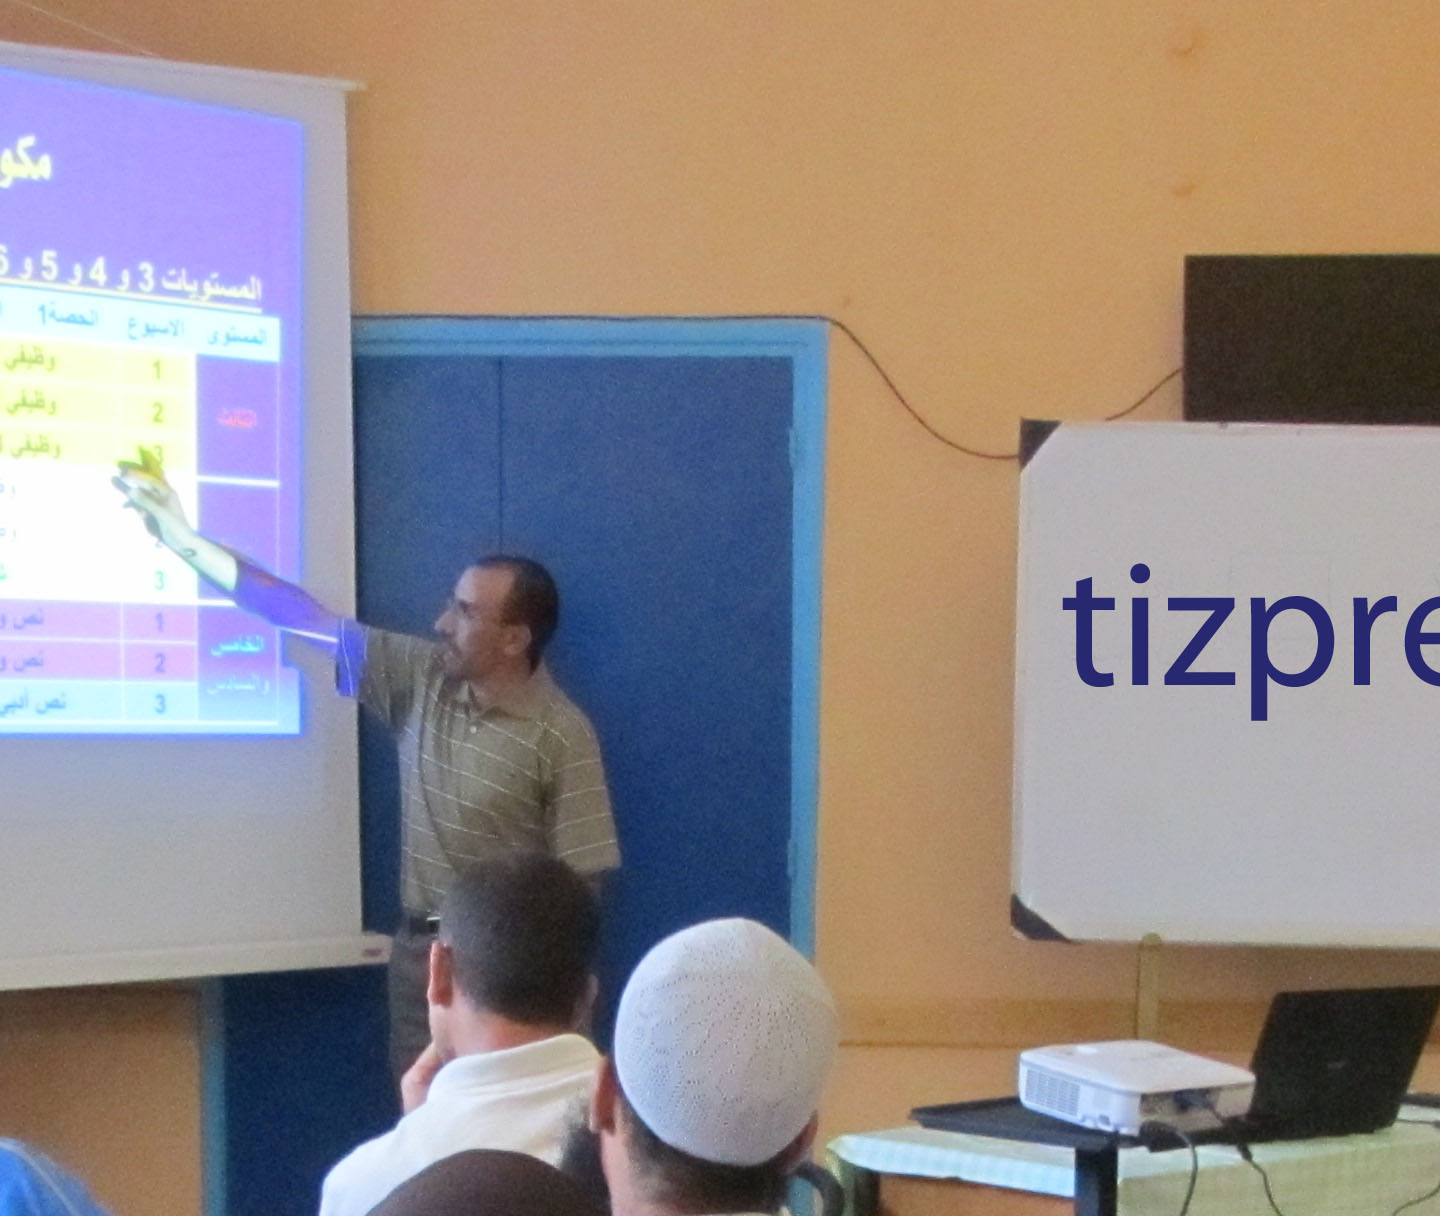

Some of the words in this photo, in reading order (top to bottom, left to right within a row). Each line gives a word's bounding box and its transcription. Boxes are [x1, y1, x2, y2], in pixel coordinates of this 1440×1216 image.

[41, 249, 58, 281] 5
[89, 256, 108, 287] 4
[138, 261, 155, 293] 3
[162, 267, 262, 302] المستويات
